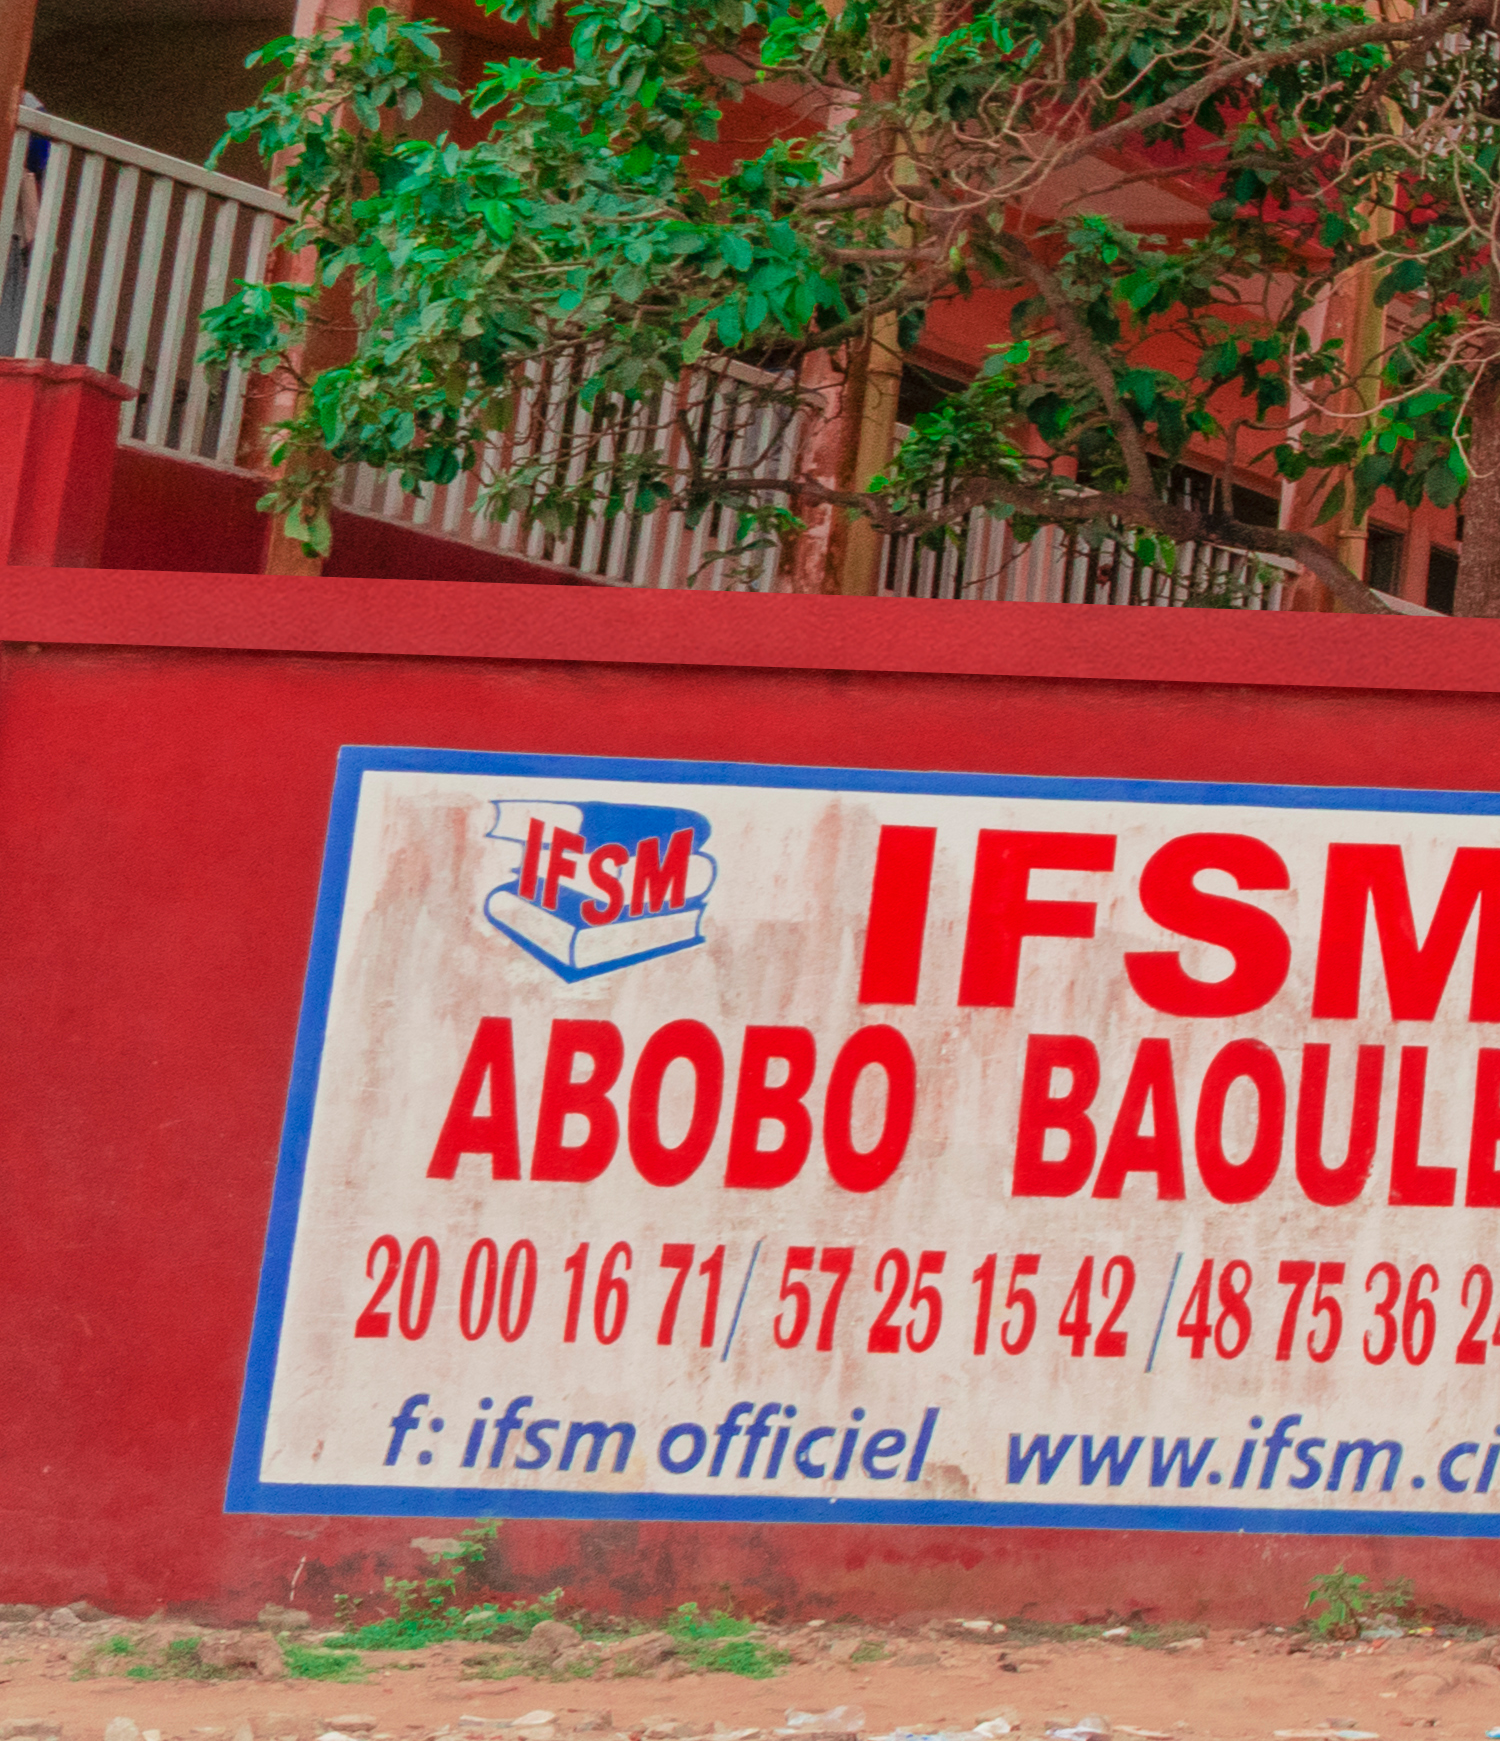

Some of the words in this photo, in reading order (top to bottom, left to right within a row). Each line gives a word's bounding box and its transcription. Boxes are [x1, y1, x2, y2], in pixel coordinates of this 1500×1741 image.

[520, 817, 697, 927] IFSM
[425, 1015, 918, 1195] ABOBO
[353, 1233, 440, 1342] 20
[458, 1237, 538, 1343] 00
[563, 1240, 632, 1346] 16
[656, 1242, 728, 1349] 71
[773, 1245, 855, 1353] 57
[866, 1247, 947, 1354] 25
[972, 1252, 1041, 1357] 15
[1057, 1254, 1136, 1359] 42
[1176, 1258, 1253, 1361] 48
[1274, 1259, 1346, 1364] 75
[1362, 1261, 1440, 1367] 36
[462, 1395, 637, 1473] ifsm
[657, 1402, 939, 1484] officiel
